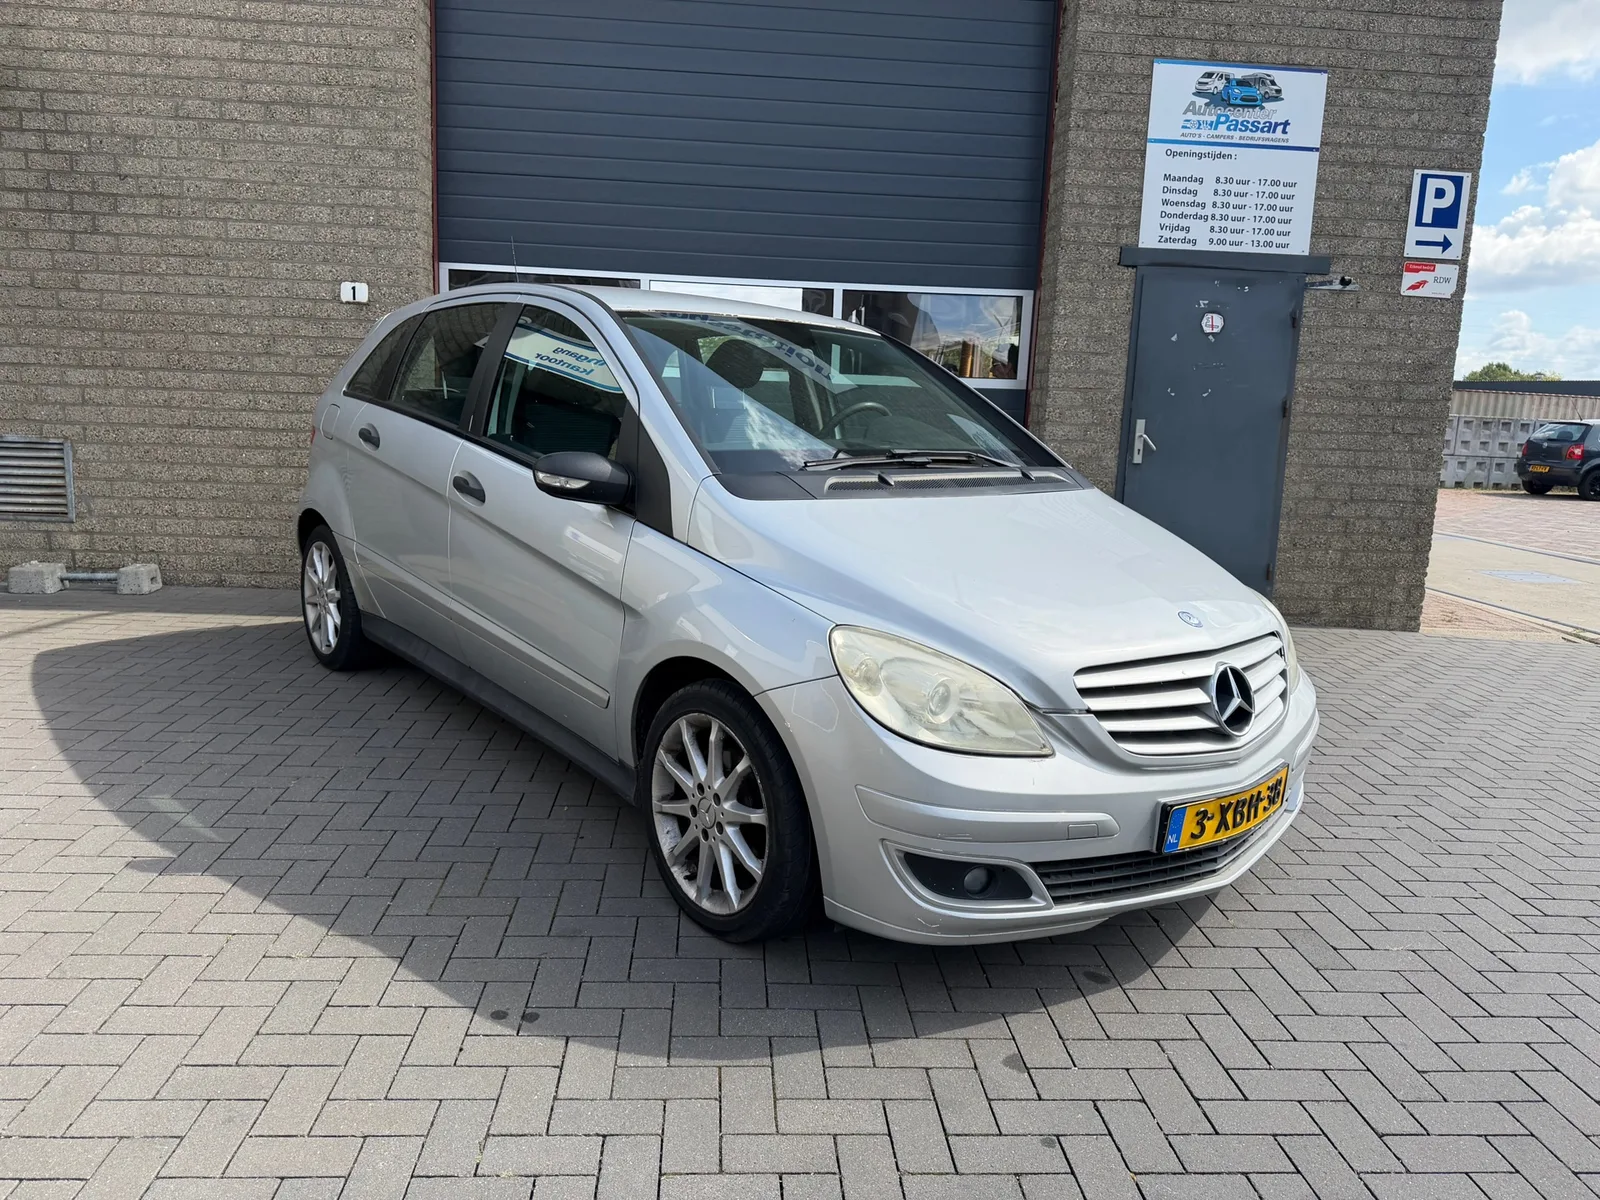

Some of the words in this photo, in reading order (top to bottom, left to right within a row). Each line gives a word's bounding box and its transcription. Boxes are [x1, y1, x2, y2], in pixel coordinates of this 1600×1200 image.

[1182, 100, 1277, 120] Autocenter
[1213, 113, 1291, 135] Passart
[1238, 135, 1289, 143] BEDRIJFSWAGENS
[1165, 148, 1233, 160] Openingstijden
[1163, 173, 1204, 185] Maandag
[1215, 177, 1234, 185] 8.30
[1258, 179, 1281, 187] 17.00
[1162, 186, 1198, 197] Dinsdag
[1213, 189, 1232, 197] 8.30
[1256, 191, 1279, 199] 17.00
[1161, 198, 1206, 210] Woensdag
[1212, 201, 1230, 209] 8.30
[1254, 203, 1277, 212] 17.00
[1279, 205, 1293, 213] uur
[1422, 178, 1455, 224] P
[1160, 211, 1209, 222] Donderdag
[1210, 213, 1229, 221] 8.30
[1253, 215, 1276, 224] 17.00
[1277, 217, 1292, 225] uur
[1159, 223, 1190, 234] Vrijdag
[1209, 226, 1228, 234] 8.30
[1252, 228, 1275, 236] 17.00
[1157, 235, 1197, 246] Zaterdag
[1208, 238, 1227, 246] 9.00
[1228, 239, 1243, 247] uur
[1251, 240, 1273, 248] 13.00
[1433, 276, 1452, 284] RDW
[351, 286, 356, 300] 1
[1167, 834, 1178, 844] NL
